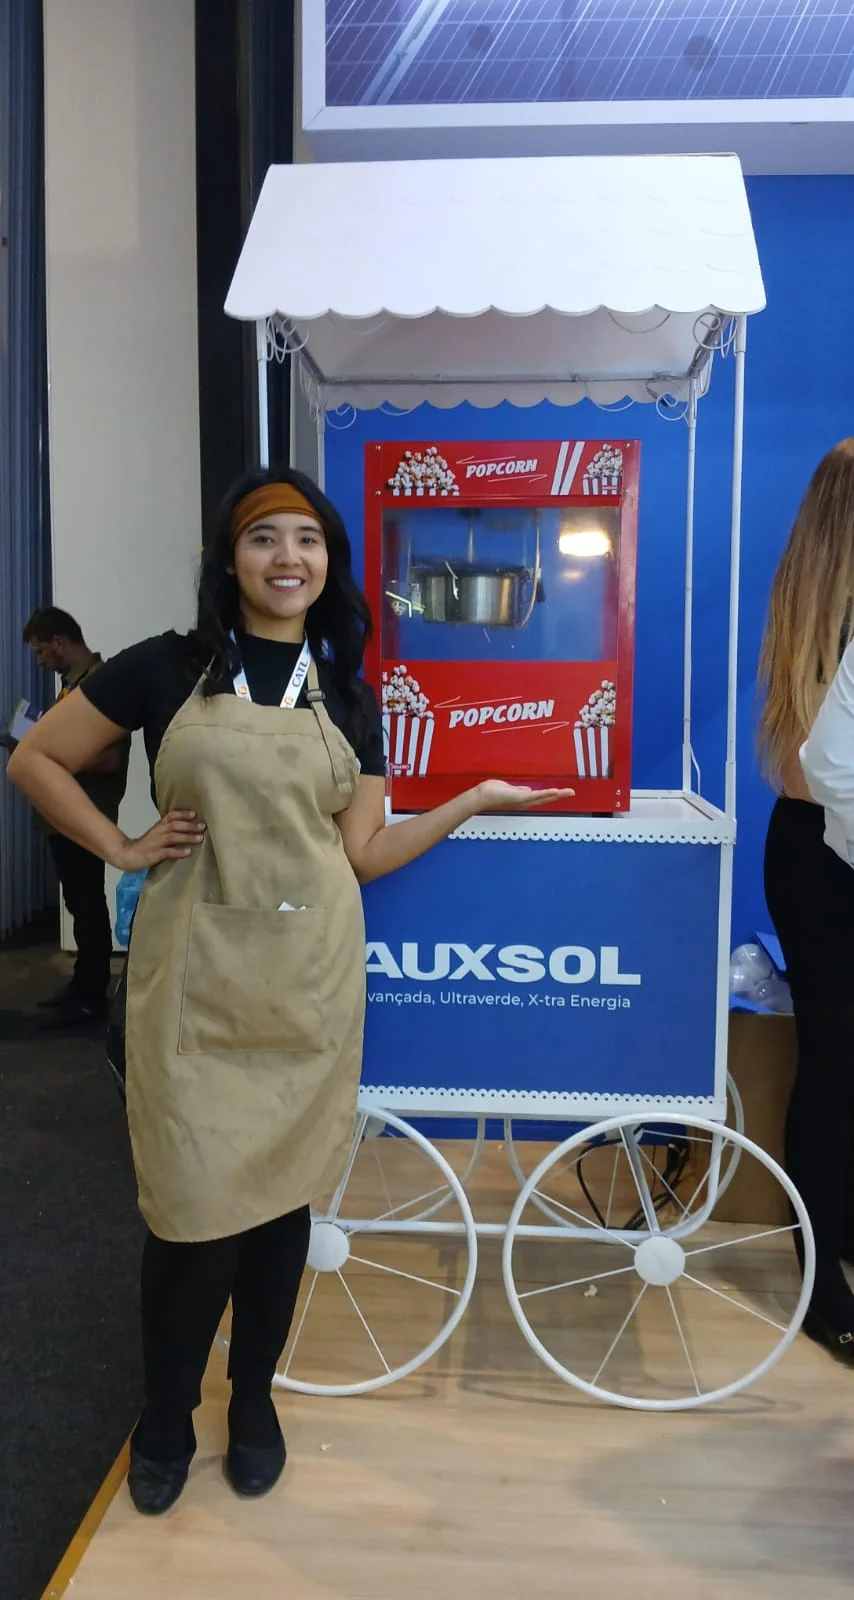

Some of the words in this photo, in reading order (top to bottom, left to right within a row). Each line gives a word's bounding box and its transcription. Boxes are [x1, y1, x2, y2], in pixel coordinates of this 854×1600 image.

[465, 459, 538, 479] POPCORN
[292, 661, 308, 688] CATL
[449, 699, 555, 729] POPCORN
[366, 941, 641, 986] AUXSOL
[367, 991, 436, 1006] vançada,
[440, 991, 524, 1008] Ultraverde,
[528, 993, 566, 1007] X-tra
[570, 994, 632, 1011] Energia
